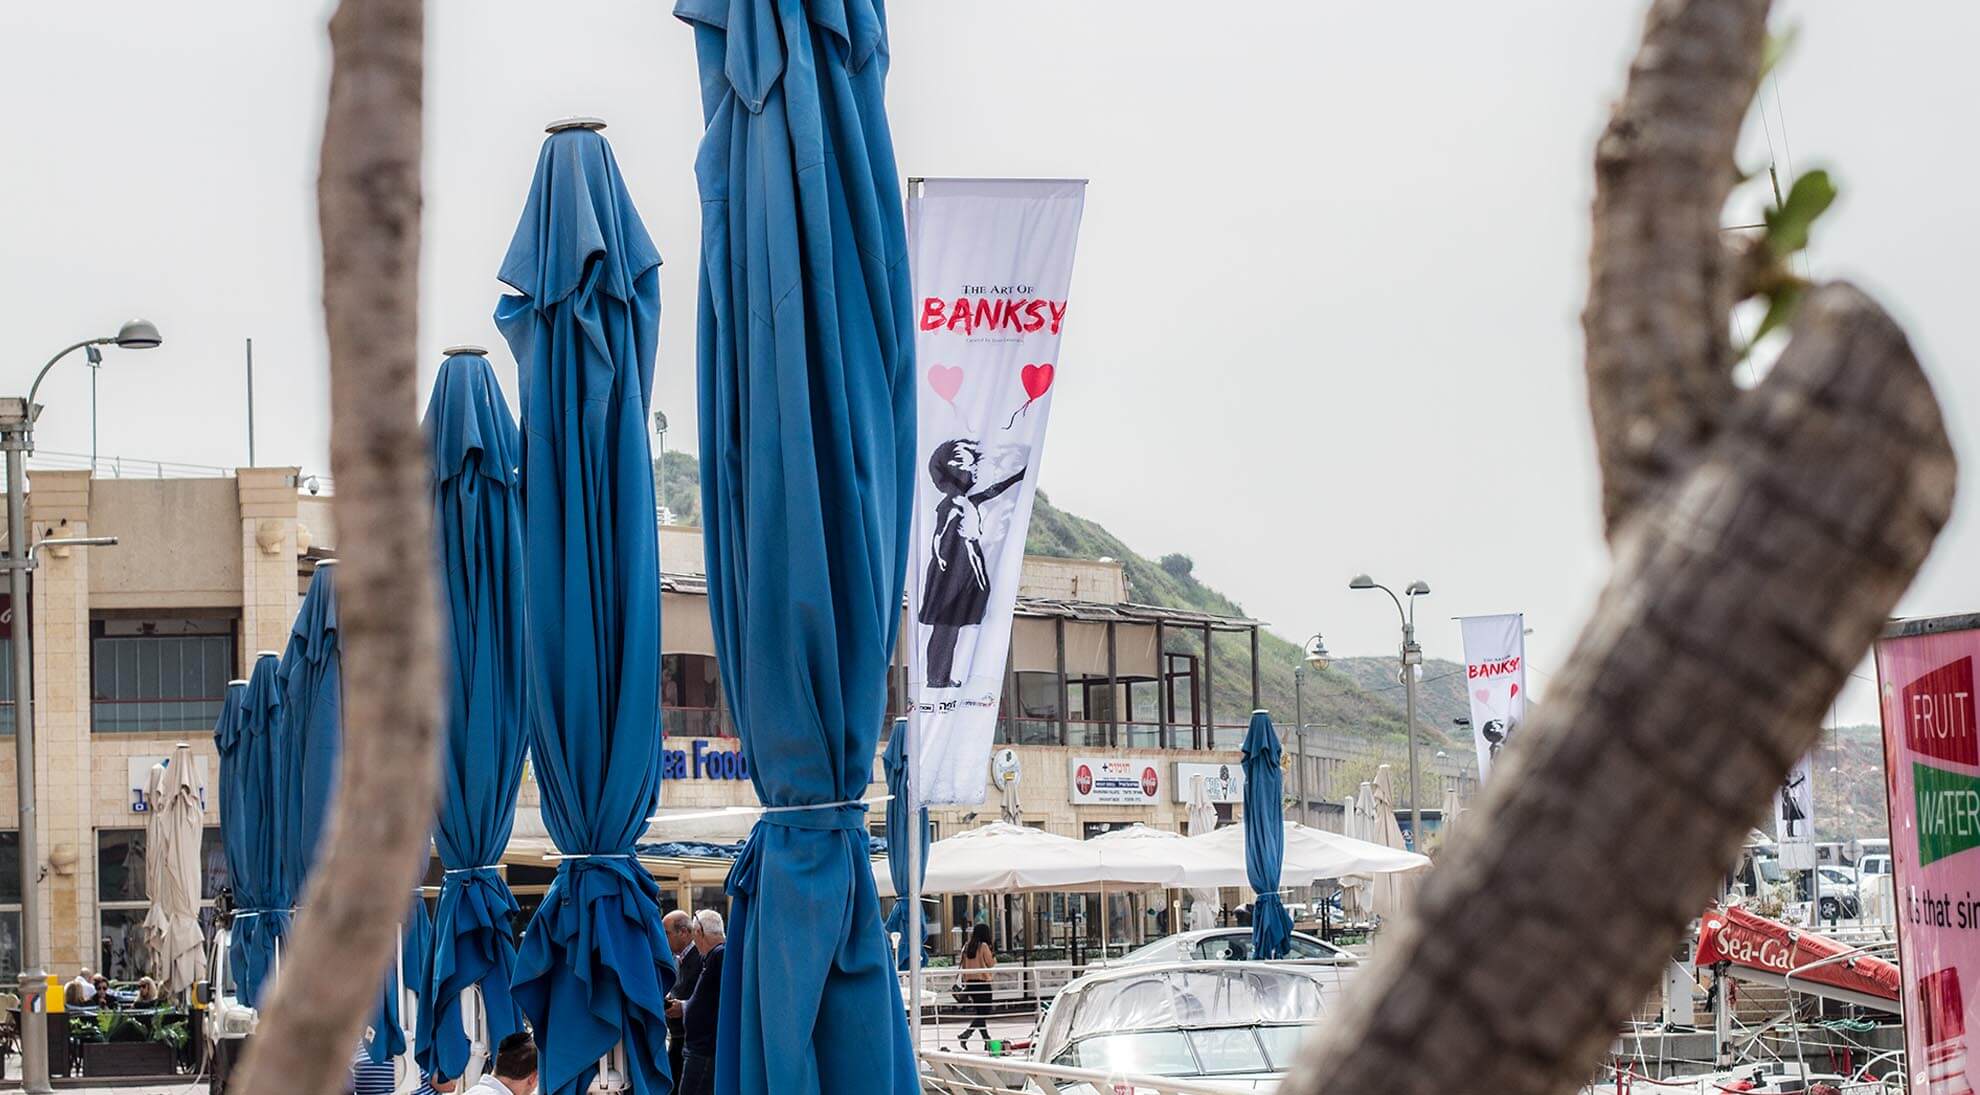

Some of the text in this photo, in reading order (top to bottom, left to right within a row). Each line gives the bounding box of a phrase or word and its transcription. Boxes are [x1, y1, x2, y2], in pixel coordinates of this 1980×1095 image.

[920, 297, 1067, 336] BANKSY
[1912, 692, 1968, 739] FRUIT
[662, 750, 686, 779] ea
[1919, 790, 1980, 836] WATER
[1922, 889, 1952, 928] that
[1716, 924, 1799, 970] Sea-Gal
